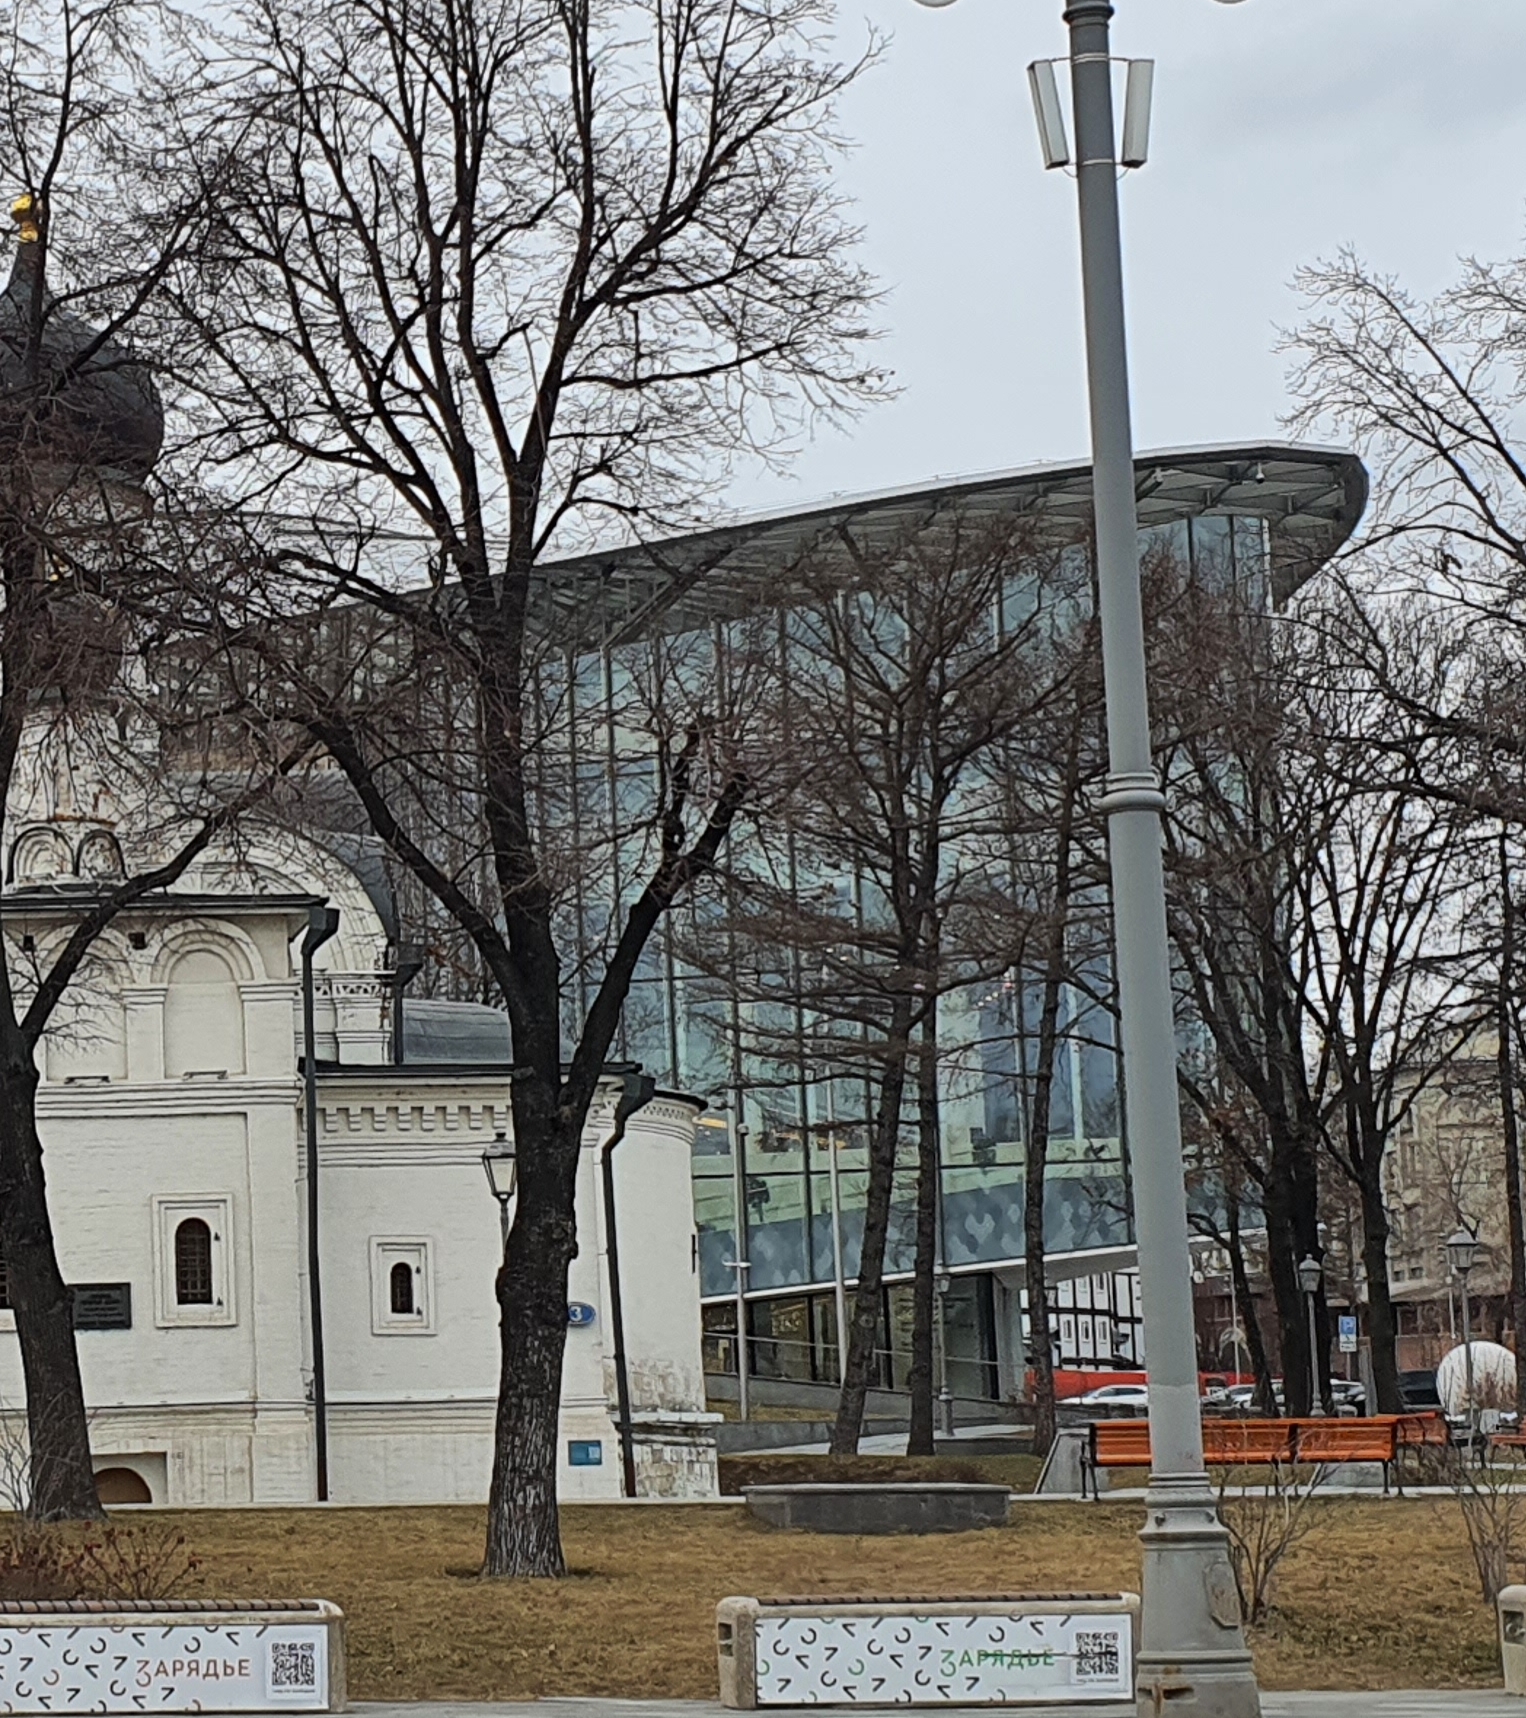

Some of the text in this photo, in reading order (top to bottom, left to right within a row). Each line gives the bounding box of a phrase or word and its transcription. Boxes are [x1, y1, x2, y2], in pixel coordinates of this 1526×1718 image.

[569, 1305, 583, 1322] 3
[135, 1659, 252, 1688] ЗАРЯДЬЕ
[940, 1649, 1056, 1678] ЗАРЯДЬЕ
